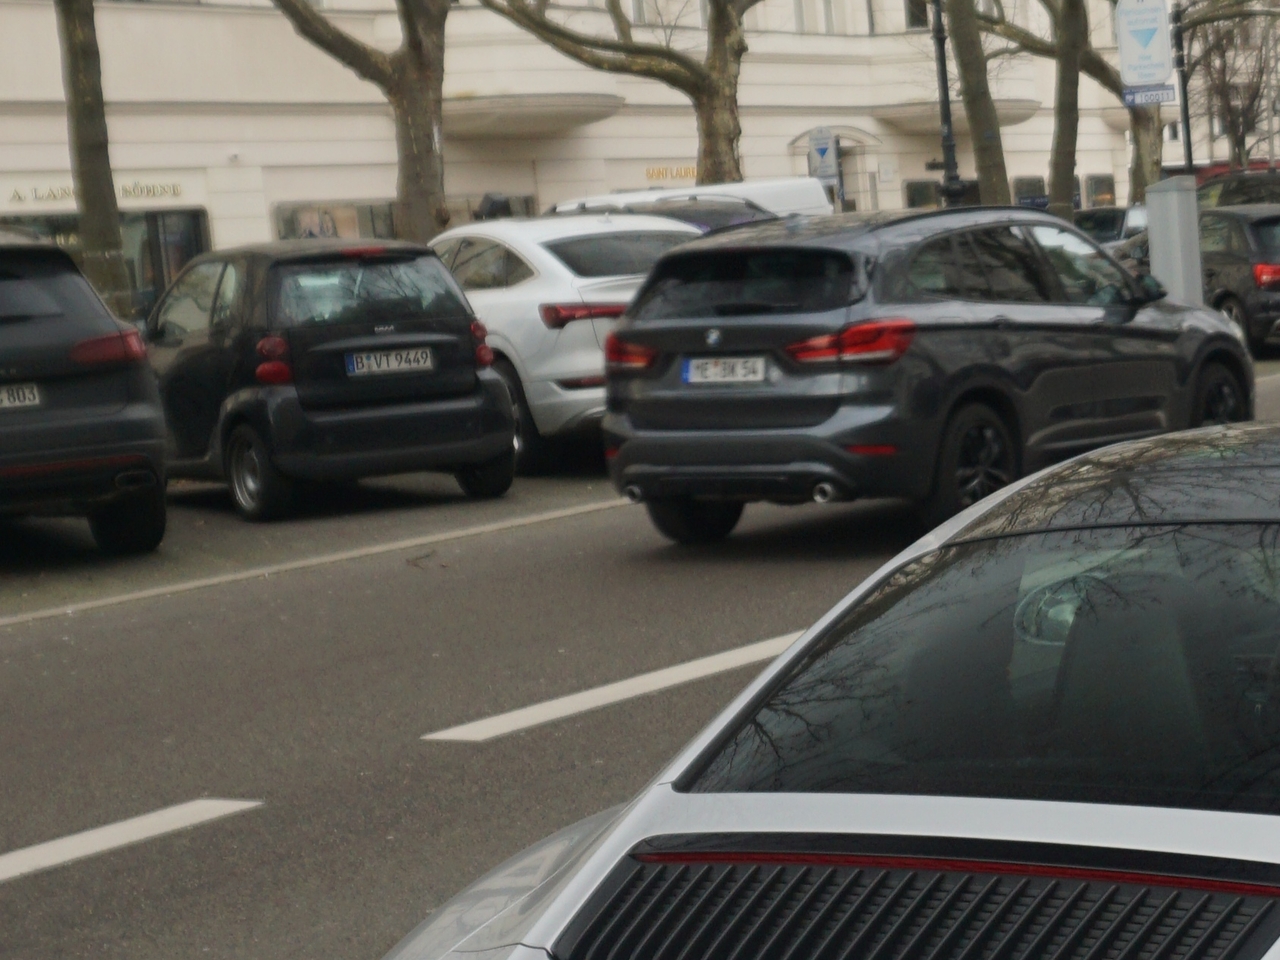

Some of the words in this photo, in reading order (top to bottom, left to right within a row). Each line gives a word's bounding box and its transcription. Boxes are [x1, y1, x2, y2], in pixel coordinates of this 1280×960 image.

[646, 167, 668, 179] SAINT
[670, 166, 697, 179] LAURE
[355, 354, 364, 371] B
[373, 353, 391, 369] VT
[395, 350, 428, 367] 9449
[7, 385, 37, 404] 803
